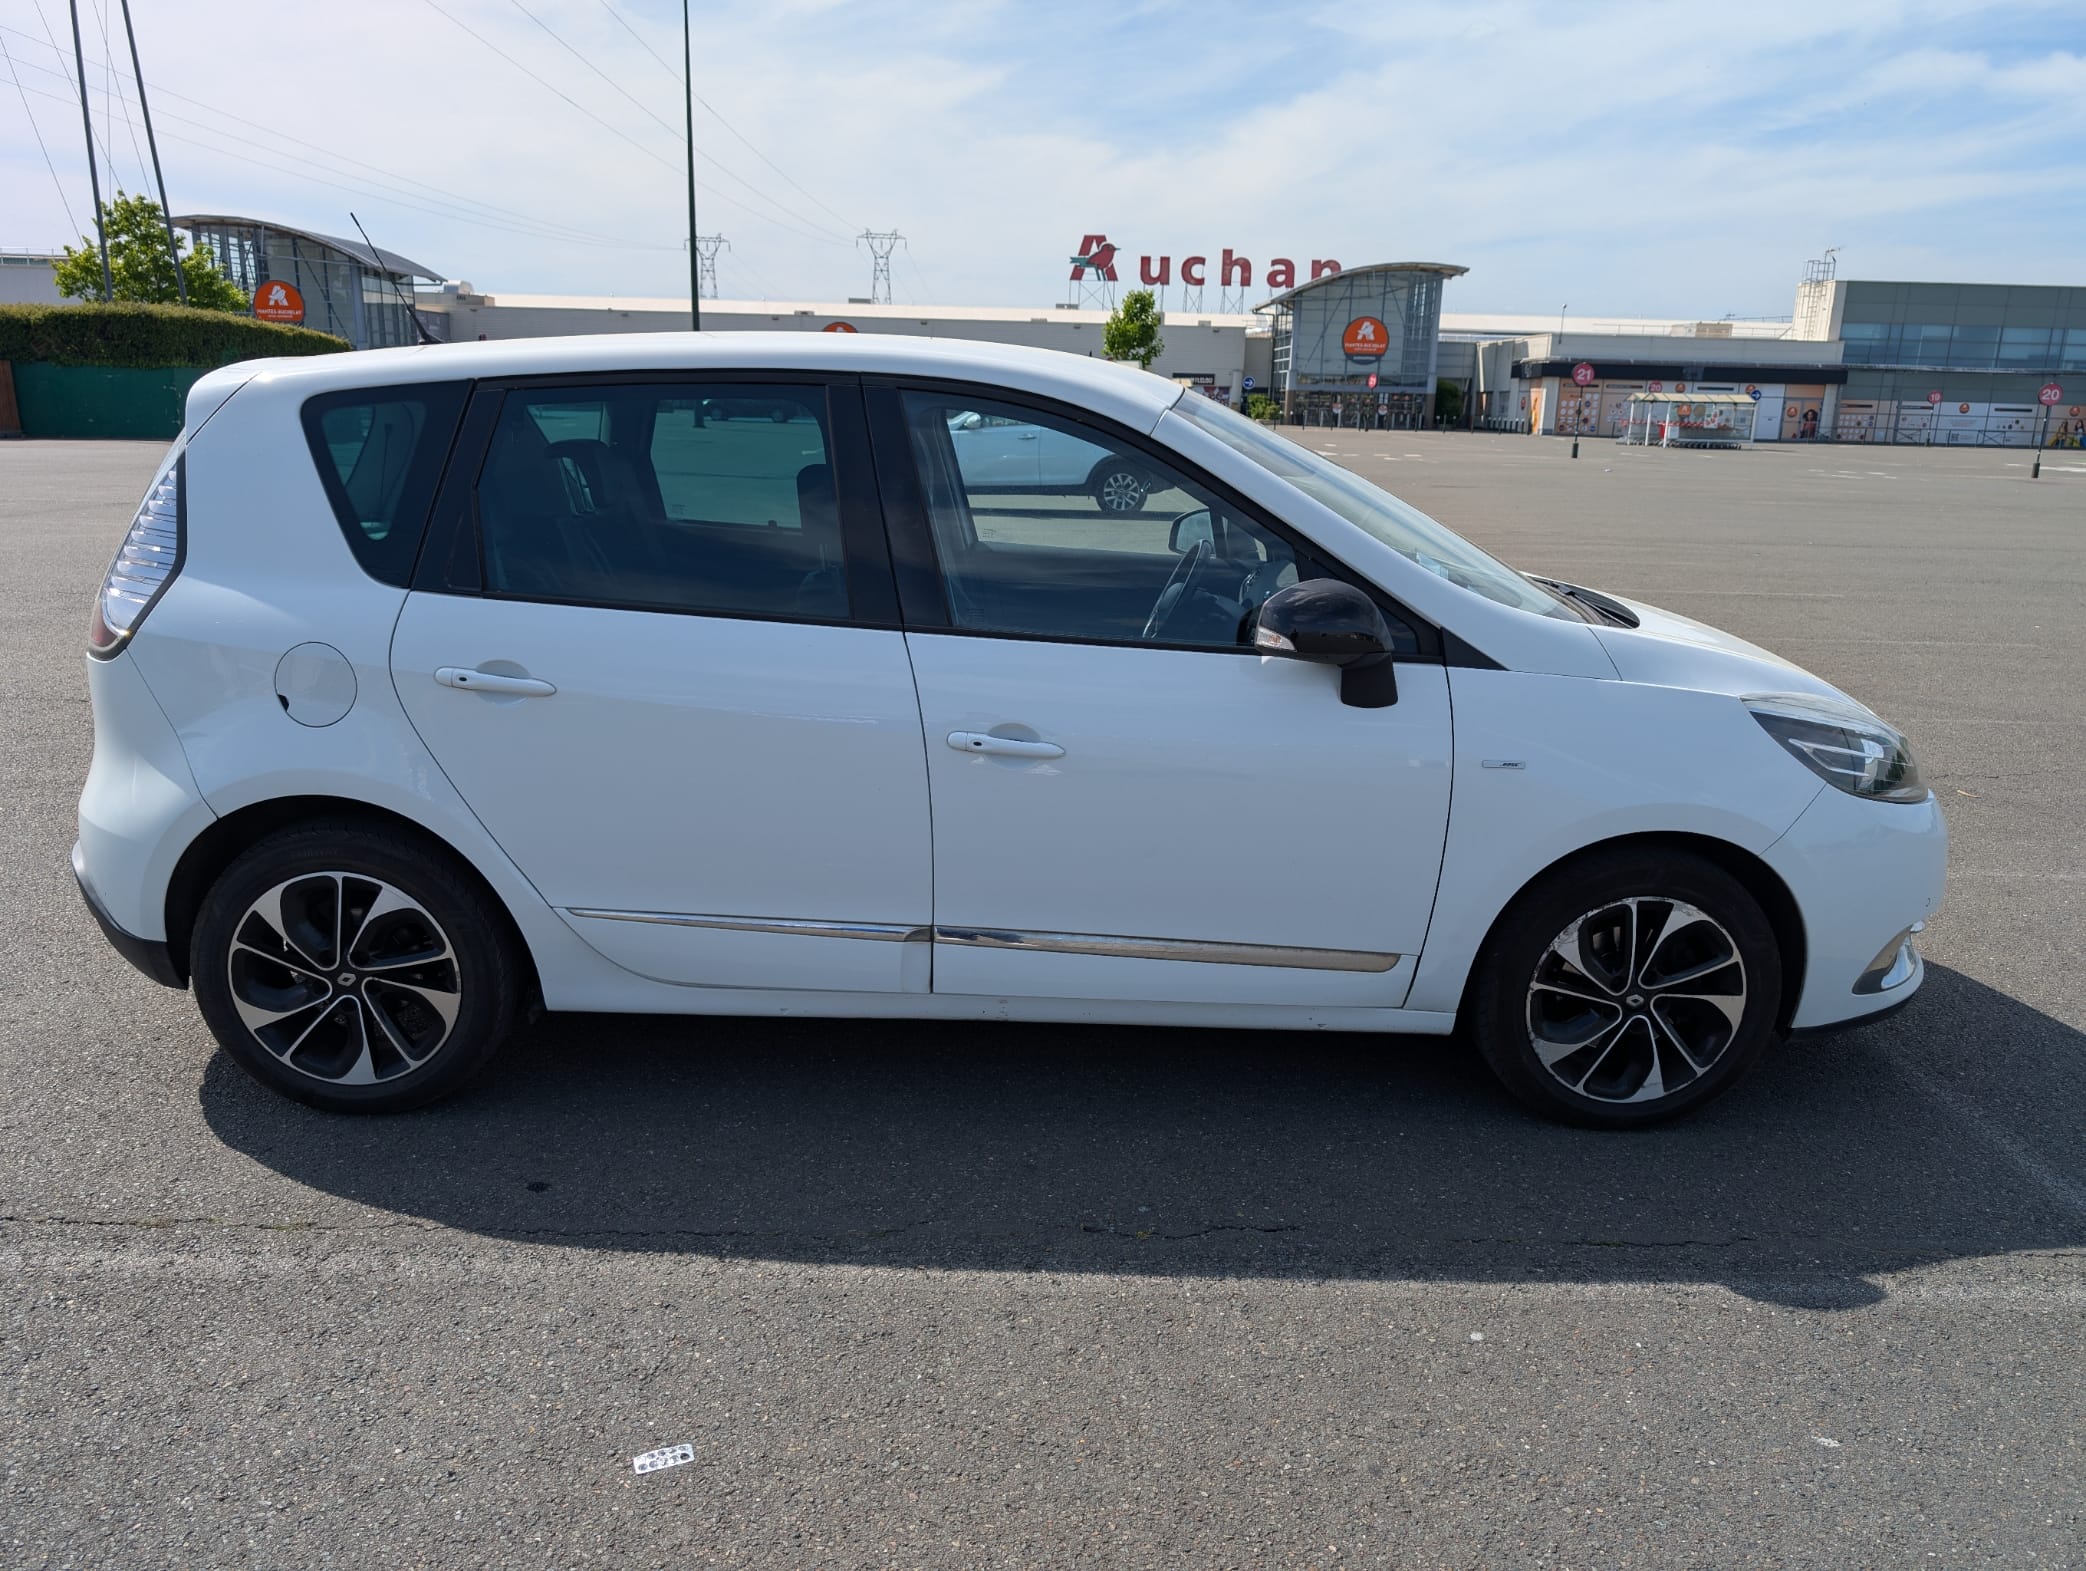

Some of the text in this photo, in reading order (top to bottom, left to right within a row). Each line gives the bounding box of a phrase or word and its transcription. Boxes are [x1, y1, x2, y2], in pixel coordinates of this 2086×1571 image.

[1070, 234, 1342, 289] Auchan
[1576, 368, 1591, 380] 21
[2041, 389, 2060, 401] 20
